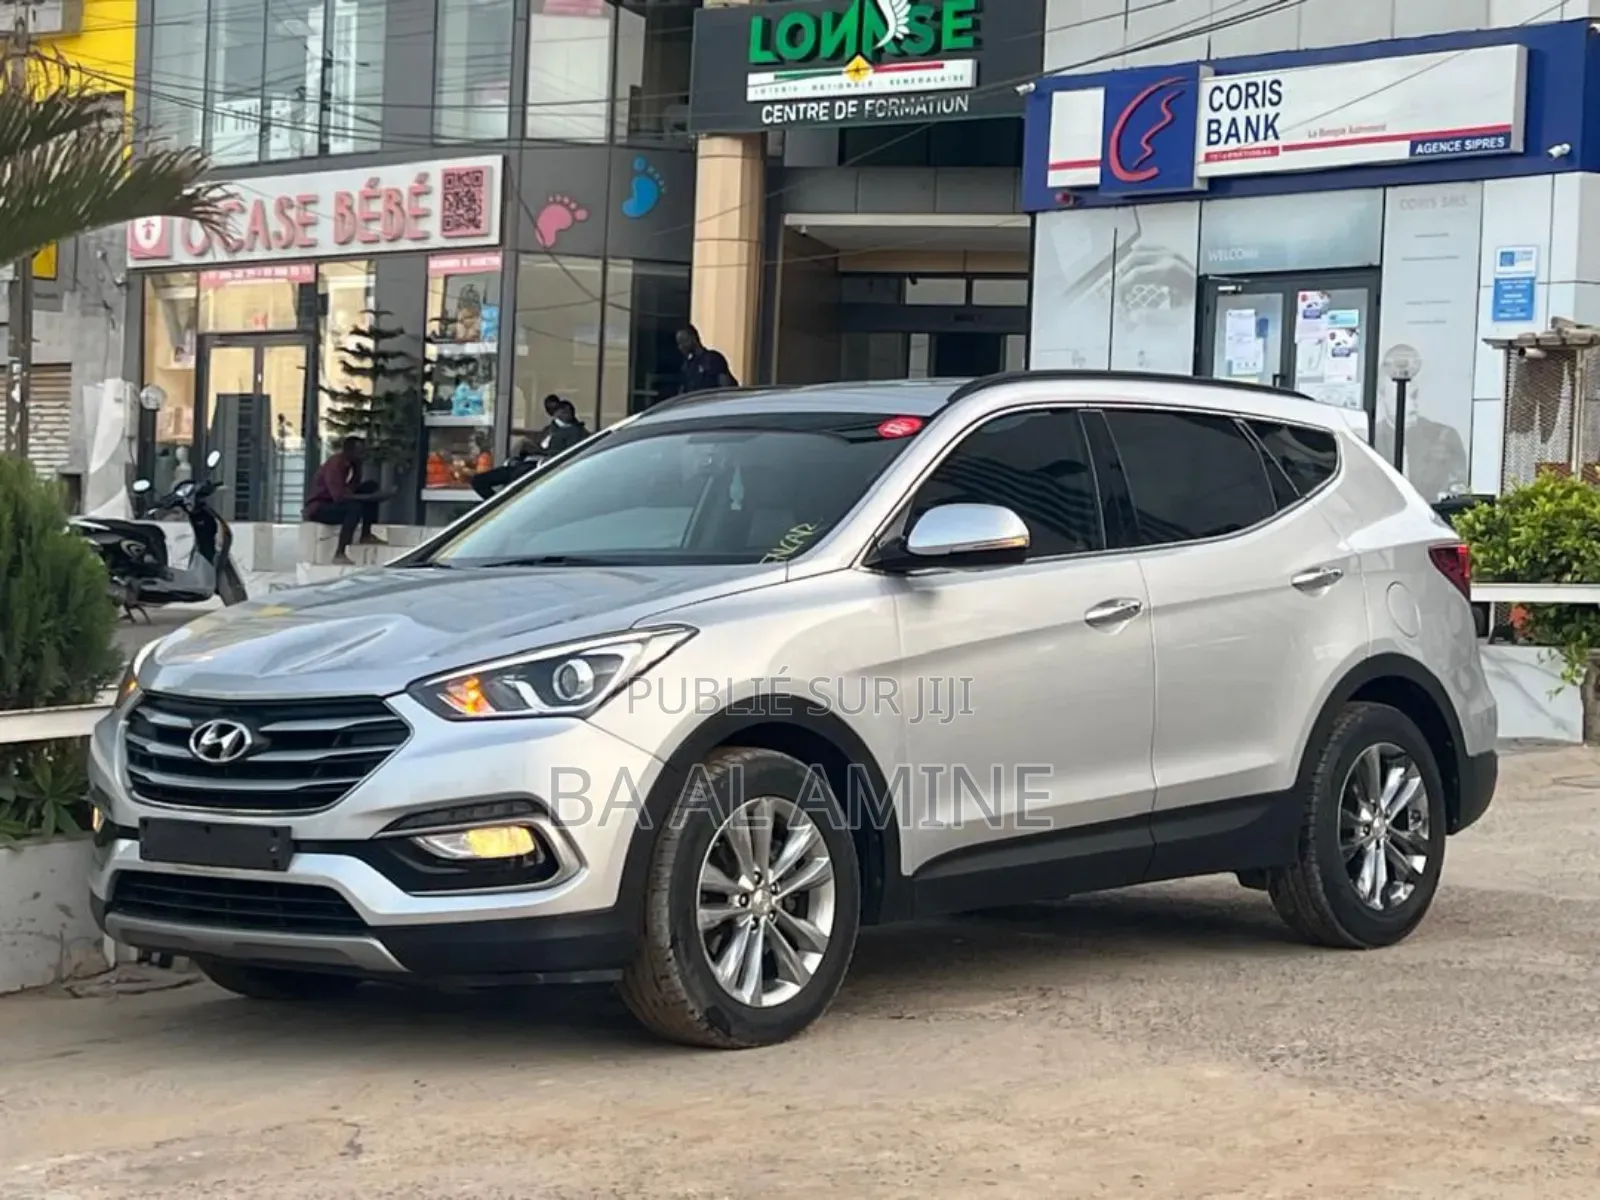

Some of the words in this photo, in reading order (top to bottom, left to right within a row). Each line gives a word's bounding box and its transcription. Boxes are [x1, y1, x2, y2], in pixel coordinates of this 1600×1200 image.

[748, 0, 978, 62] LONASE
[761, 101, 830, 124] CENTRE
[834, 100, 859, 120] DE
[864, 94, 969, 118] FORMATION
[1208, 79, 1283, 112] CORIS
[1206, 112, 1281, 146] BANK
[1415, 140, 1462, 155] AGENCE
[1464, 136, 1506, 151] SIPRES
[333, 171, 432, 246] BÉBÉ
